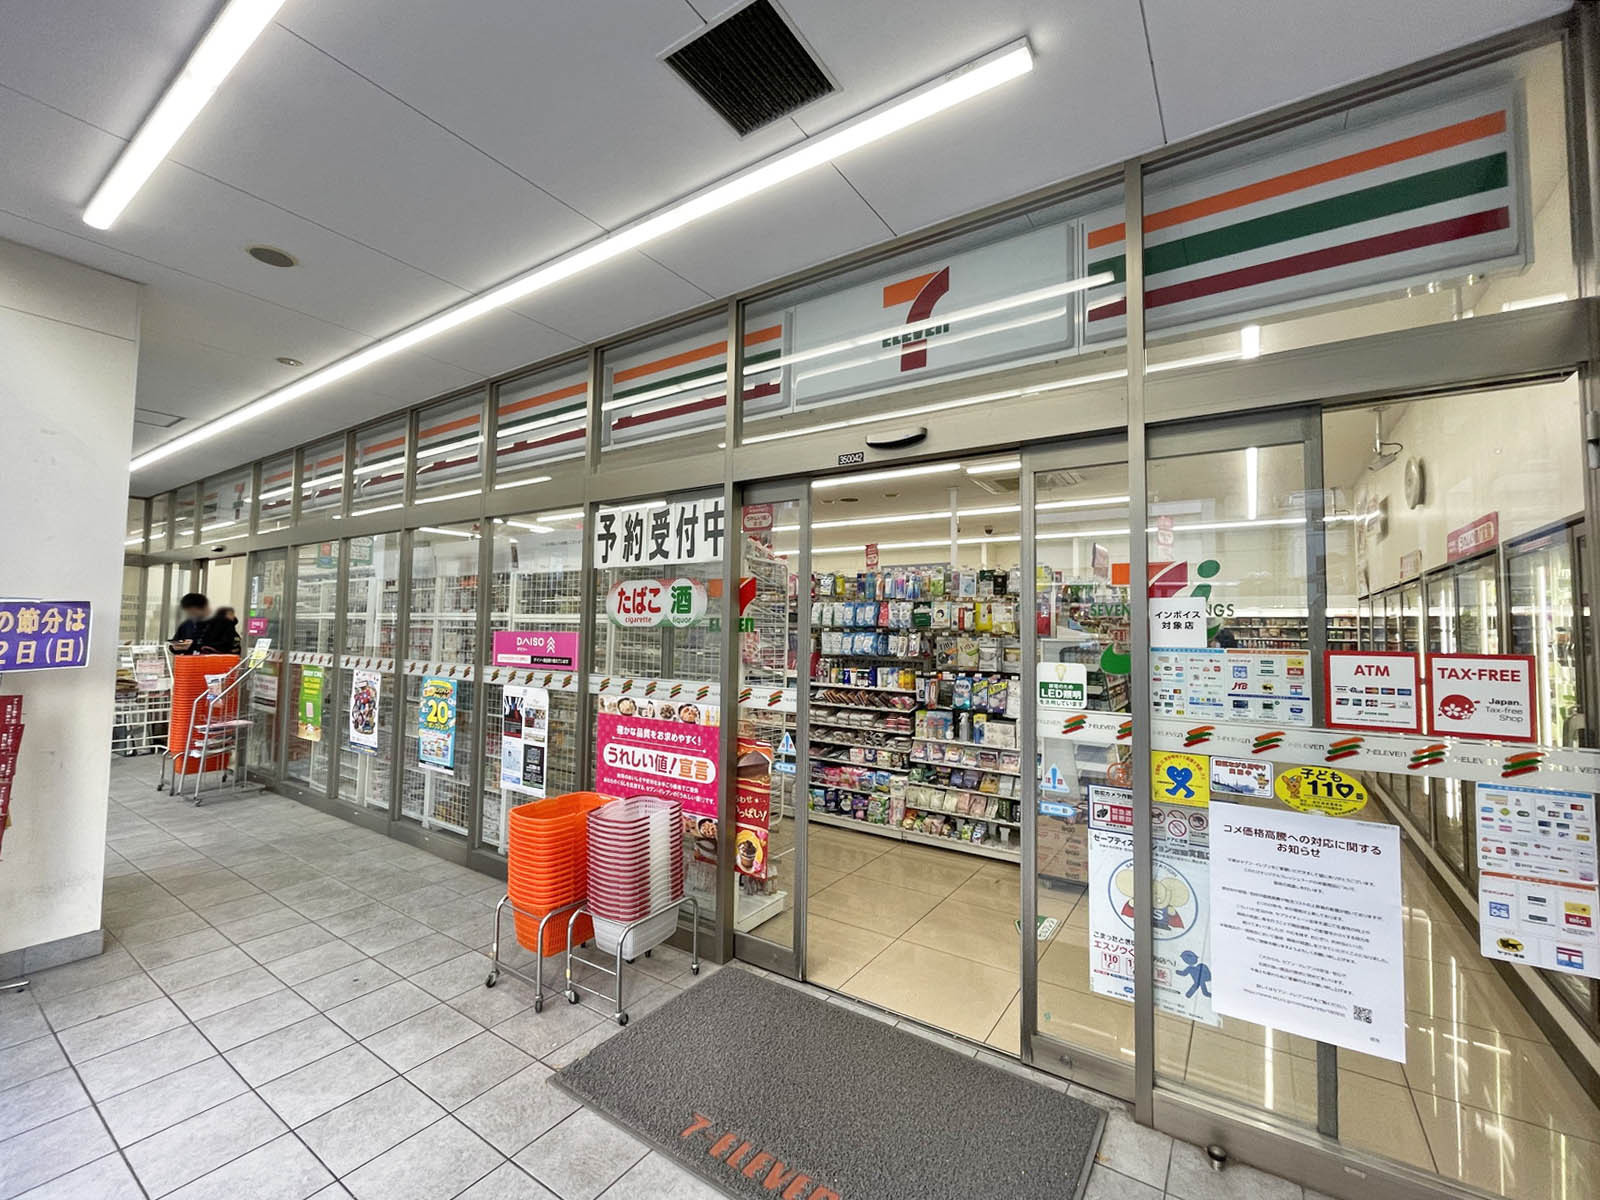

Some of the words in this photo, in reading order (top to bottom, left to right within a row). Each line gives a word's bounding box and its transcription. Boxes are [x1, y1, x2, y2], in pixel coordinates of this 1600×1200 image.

[598, 501, 724, 563] 予約受付中
[617, 586, 661, 614] たばこ
[671, 585, 692, 614] 酒
[0, 607, 85, 634] の節分は
[625, 616, 652, 624] cigarette
[1155, 610, 1200, 619] インボイス
[1162, 621, 1194, 630] 対象店
[516, 637, 544, 646] DAISO
[1354, 665, 1390, 677] ATM
[1437, 667, 1521, 682] TAX-FREE
[427, 700, 448, 724] 20
[1486, 706, 1523, 715] Tax-free
[1499, 715, 1523, 723] Shop
[1301, 768, 1342, 782] 子ども
[1223, 824, 1383, 856] コメ価格高騰への対応に関する
[1276, 843, 1321, 858] お知らせ
